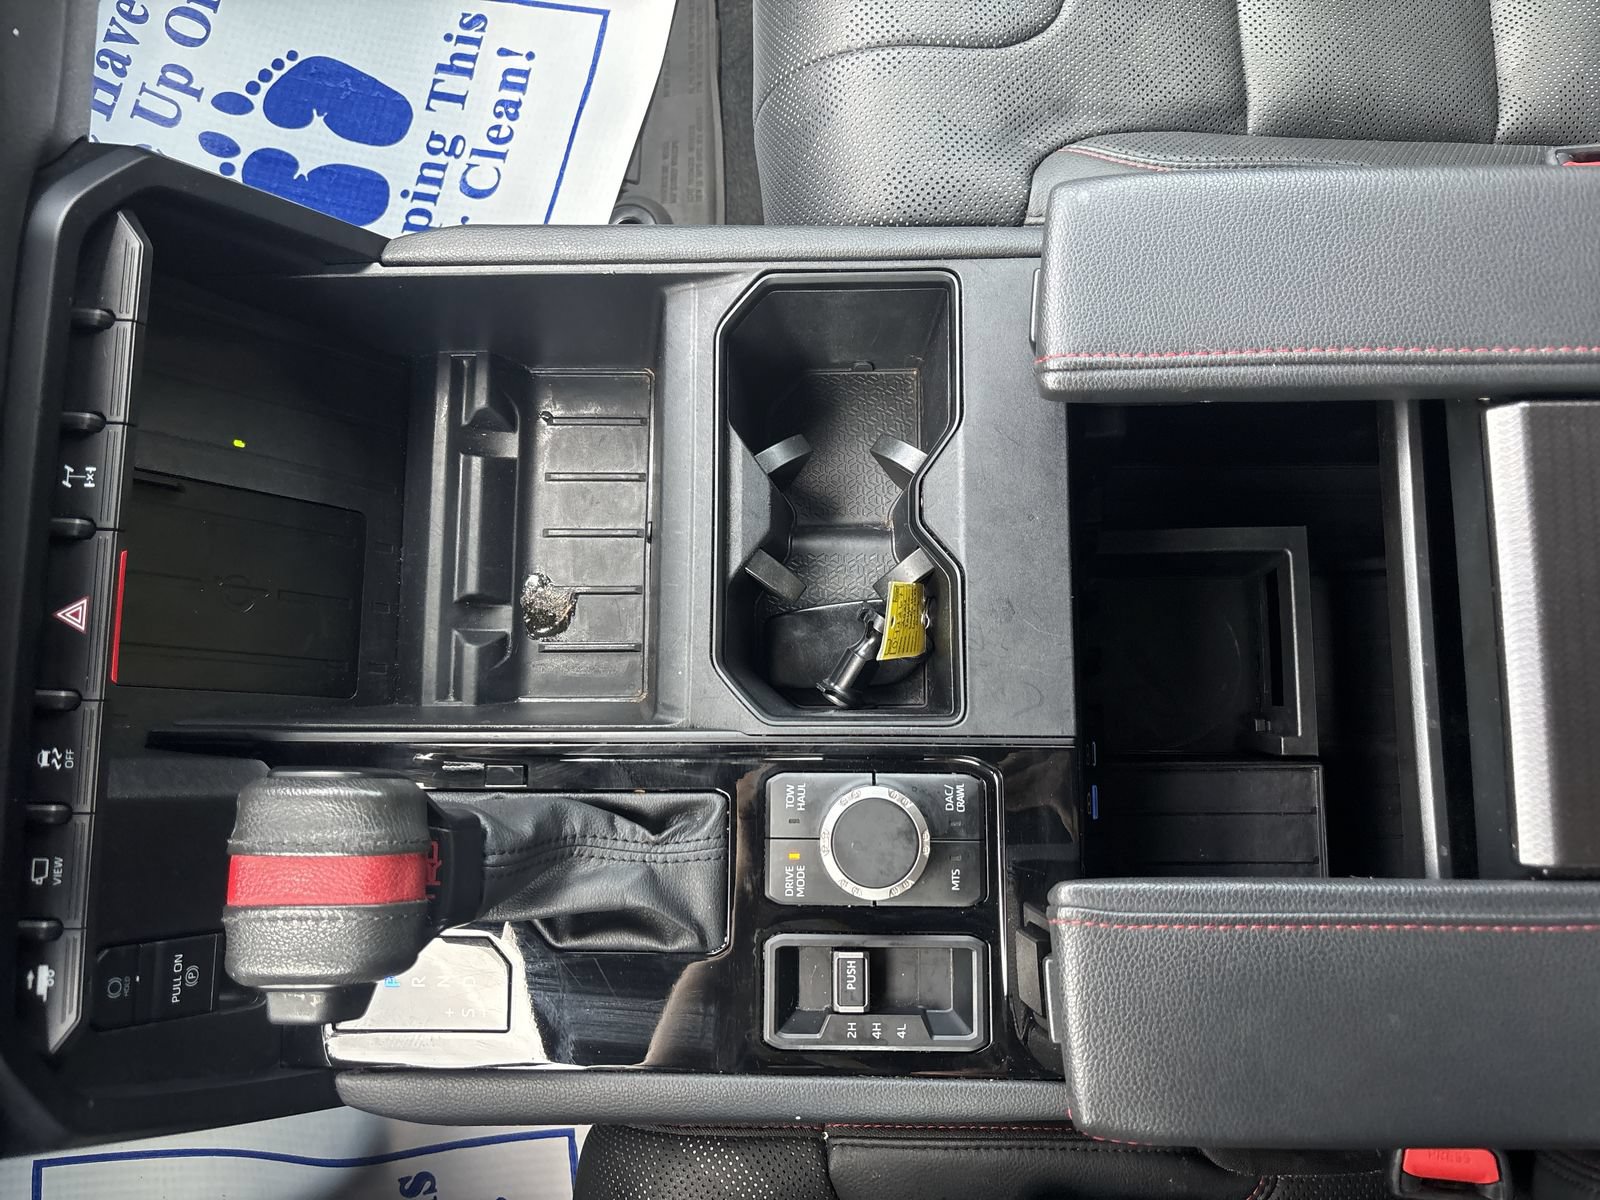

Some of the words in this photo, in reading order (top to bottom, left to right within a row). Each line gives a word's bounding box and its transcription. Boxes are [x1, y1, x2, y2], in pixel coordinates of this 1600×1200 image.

[425, 12, 488, 112] This
[130, 63, 204, 128] Up
[459, 47, 536, 199] Clean!
[65, 749, 74, 769] OFF
[785, 784, 795, 809] TOW
[797, 783, 806, 811] HAUL
[945, 784, 954, 811] DAC/
[956, 784, 966, 813] CRAWL
[53, 857, 63, 885] VIEW
[785, 865, 794, 897] DRIVE
[796, 865, 806, 897] MODE
[952, 868, 961, 891] MTS
[173, 953, 183, 973] ON
[846, 960, 857, 990] PUSH
[172, 975, 182, 1003] PULL
[384, 975, 400, 988] P
[411, 975, 426, 988] R
[461, 1008, 475, 1018] S
[847, 1022, 857, 1039] 2H
[872, 1022, 882, 1039] 4H
[896, 1023, 907, 1039] 4L
